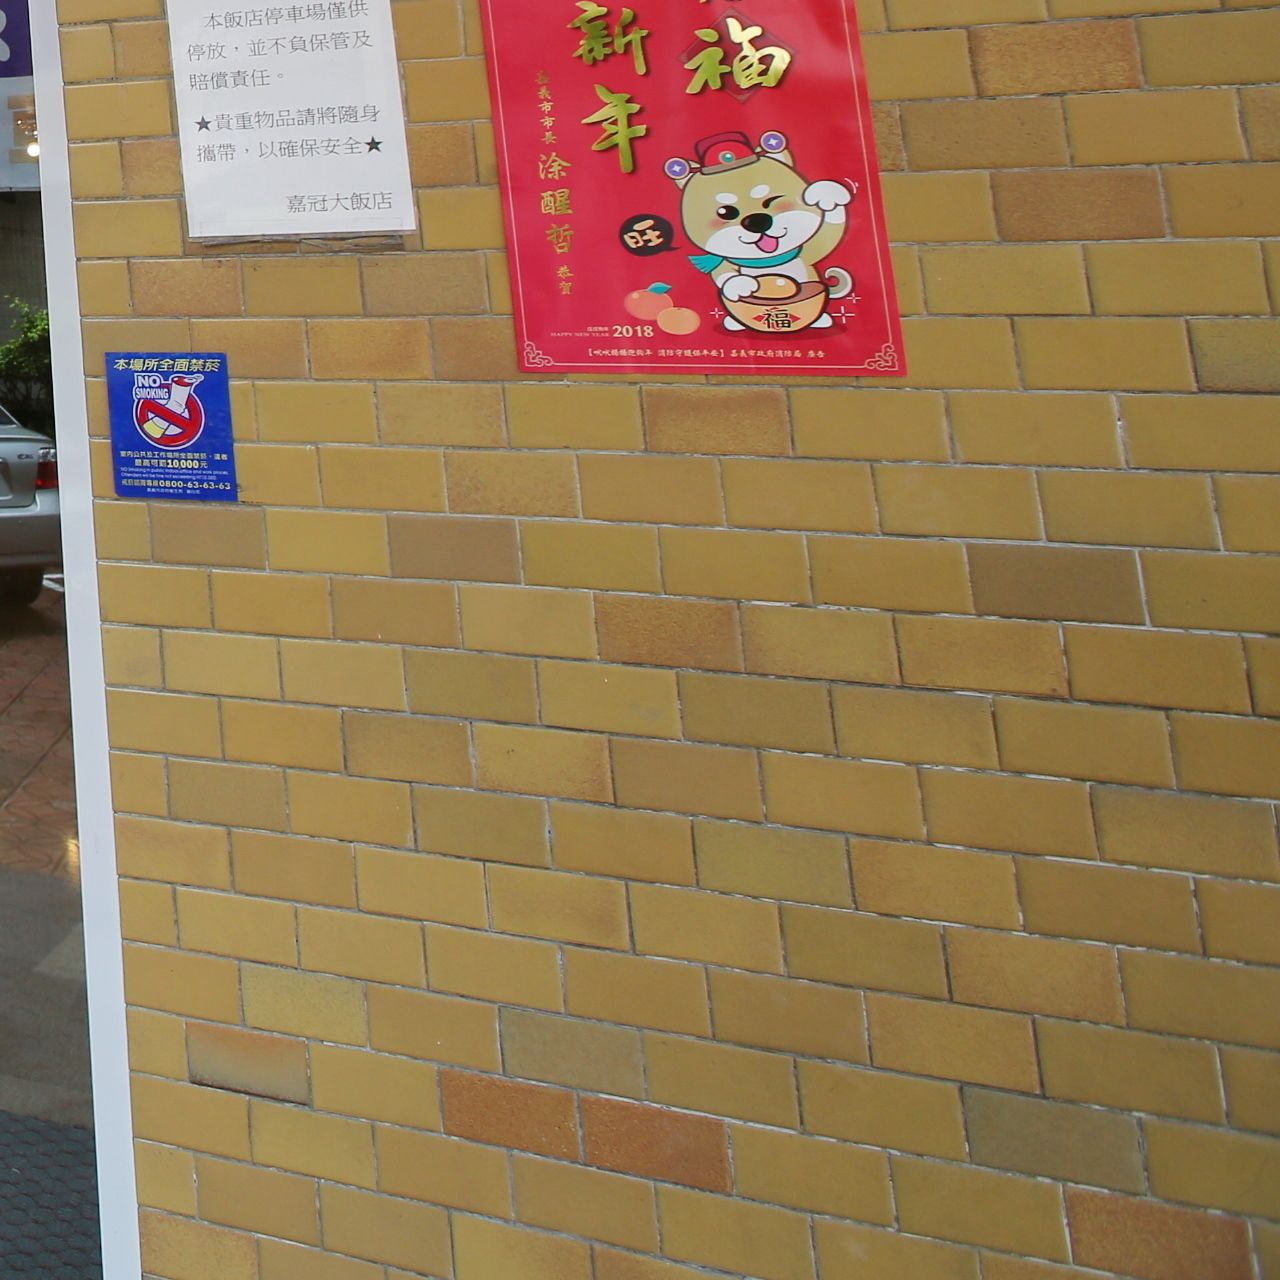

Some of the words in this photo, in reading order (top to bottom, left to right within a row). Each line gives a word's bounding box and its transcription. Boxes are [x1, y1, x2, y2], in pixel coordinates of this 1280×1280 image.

[186, 29, 375, 63] 停放，並不負保管及
[189, 68, 285, 93] 賠償責任。
[285, 191, 394, 214] 嘉冠大飯店
[538, 151, 576, 255] 涂醒哲
[623, 219, 664, 249] 旺
[556, 264, 575, 296] 恭賀
[763, 307, 792, 330] 福
[612, 324, 655, 338] 2018
[113, 358, 221, 372] 本場所全面禁菸
[137, 375, 162, 388] NO
[135, 387, 170, 400] SMOKING
